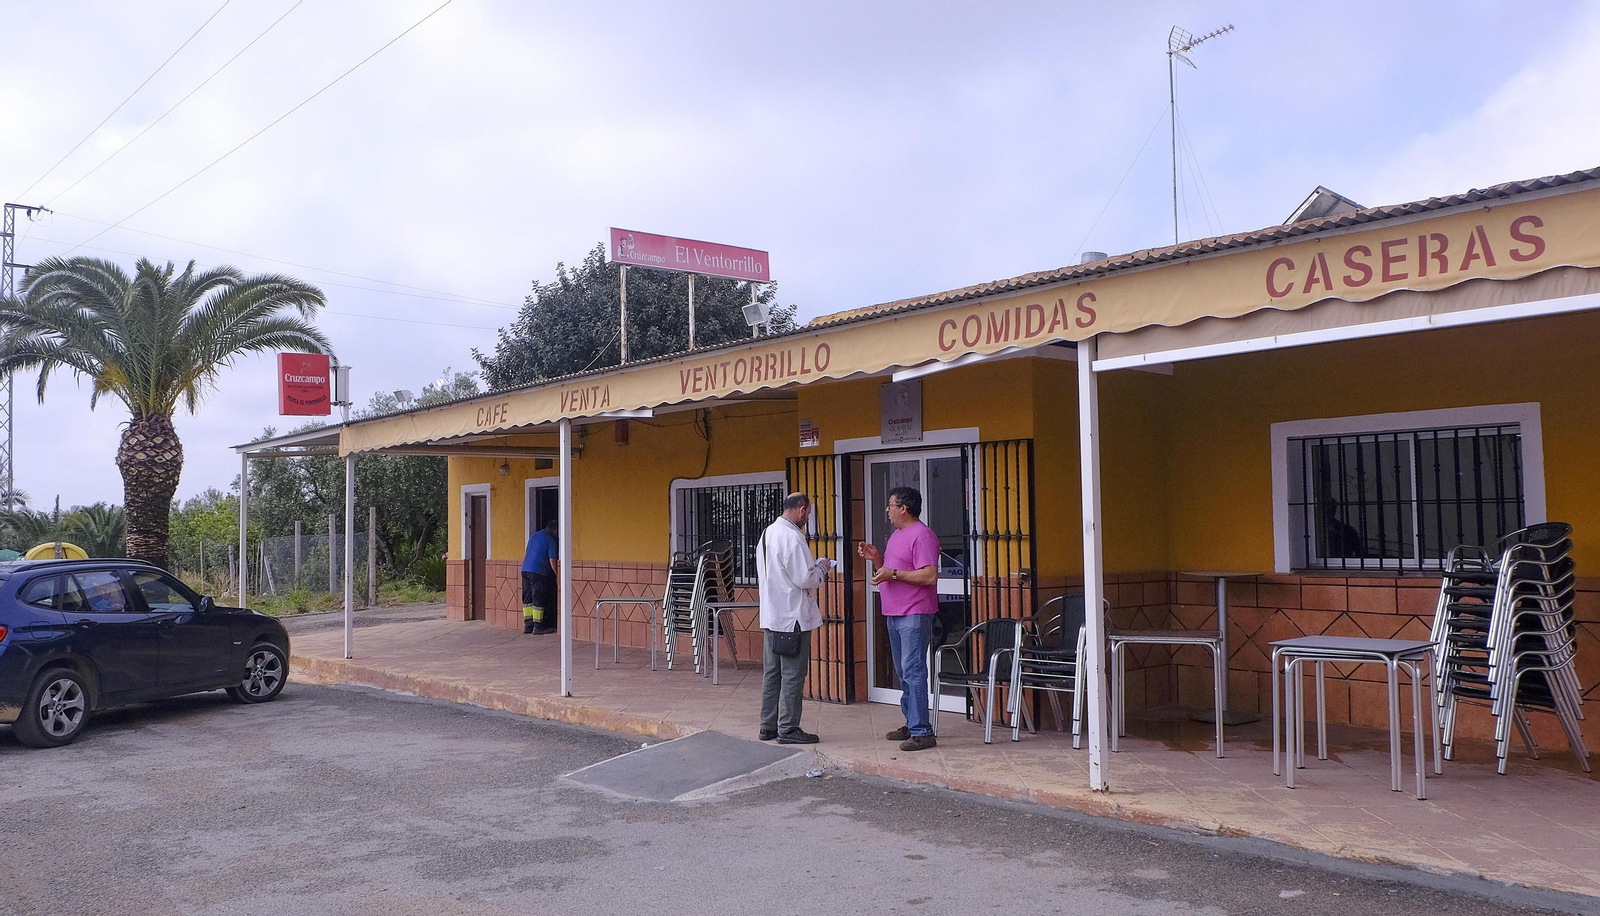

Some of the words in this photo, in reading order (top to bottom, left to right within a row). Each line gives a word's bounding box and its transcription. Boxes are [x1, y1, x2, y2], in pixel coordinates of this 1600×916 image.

[630, 251, 666, 264] Cruzcampo
[675, 245, 690, 264] El
[694, 247, 763, 274] Ventorrillo
[476, 402, 509, 427] CAFE
[560, 384, 611, 413] VENTA
[679, 342, 832, 395] VENTORRILLO
[938, 292, 1097, 352] COMIDAS
[1266, 215, 1546, 298] CASERAS
[285, 373, 326, 384] Cruzcampo
